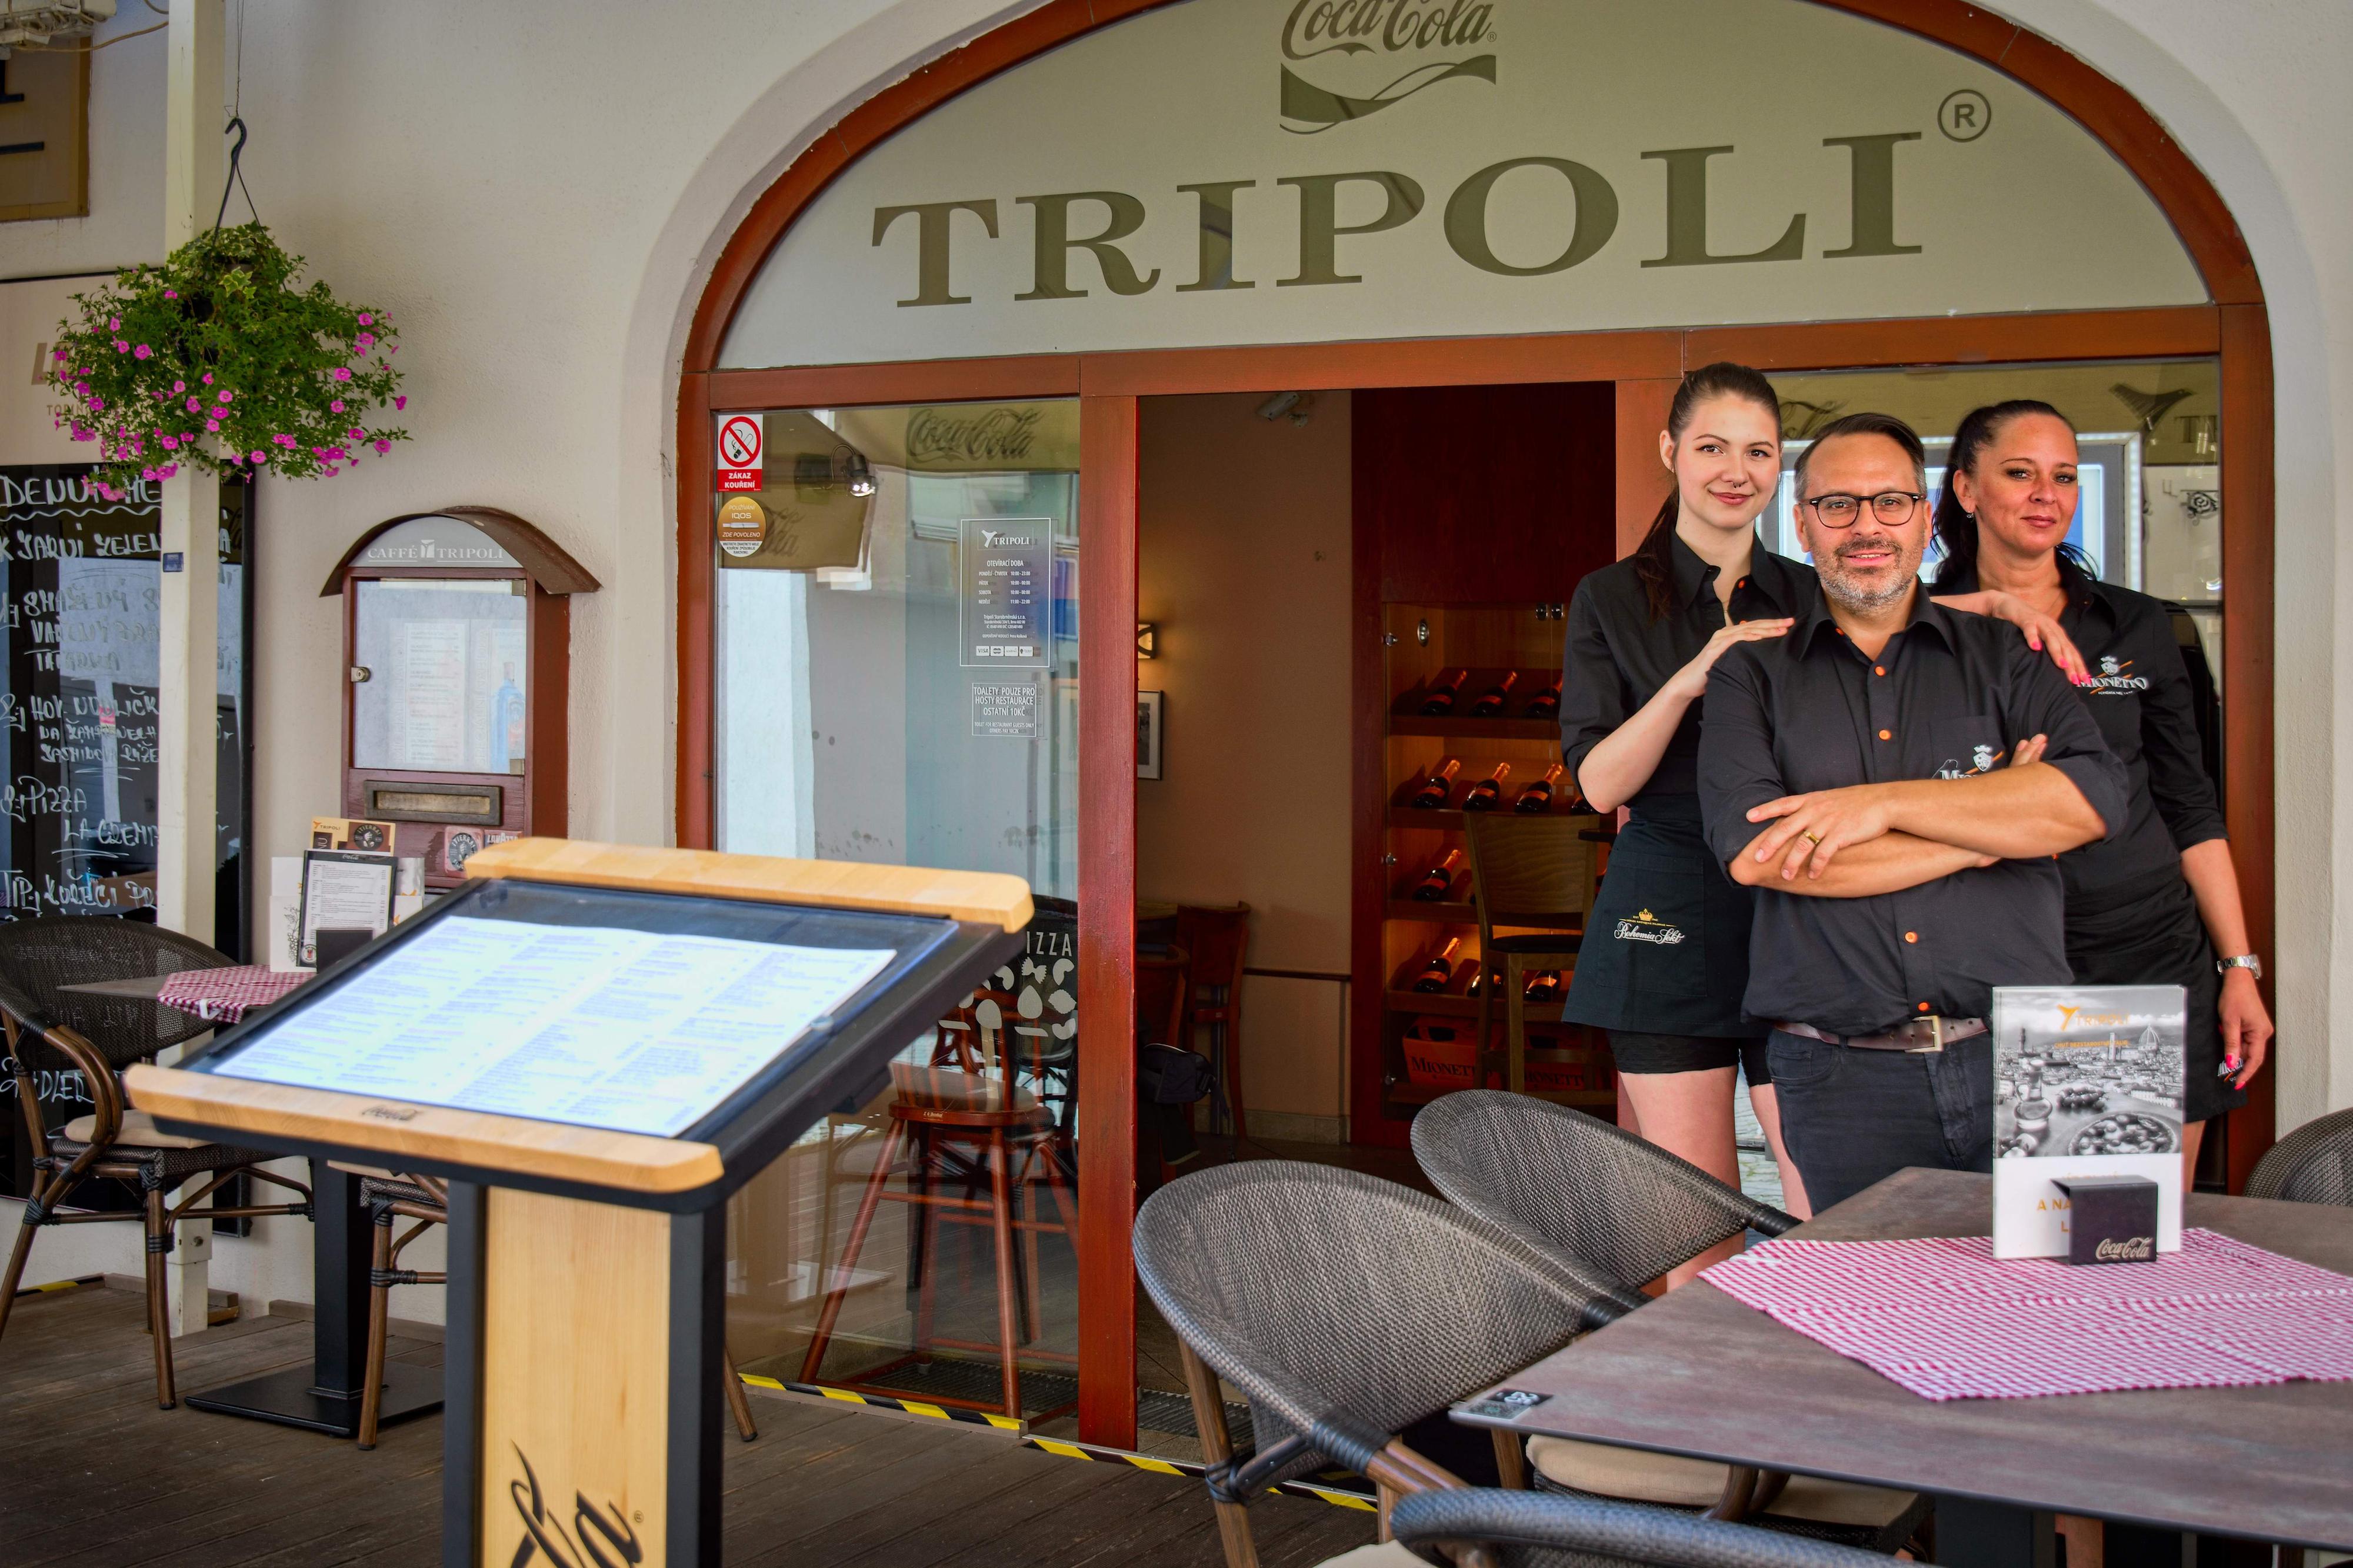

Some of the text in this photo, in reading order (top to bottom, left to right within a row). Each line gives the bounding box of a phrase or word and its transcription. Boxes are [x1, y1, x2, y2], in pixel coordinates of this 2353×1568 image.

[871, 131, 1922, 308] TRIPOLI
[994, 537, 1029, 545] TRIPOLI
[368, 545, 504, 558] CAFFÉ TRIPOLI
[987, 559, 1010, 567] OTEVÍRACÍ
[974, 687, 1035, 696] TOALETY POUZE PRO
[975, 696, 1034, 705] HOSTY RESTAURACE
[983, 706, 1025, 716] OSTATNÍ 10KČ
[1614, 921, 1685, 944] Bohemia Sekt
[1026, 931, 1072, 956] IZZA
[2077, 1013, 2129, 1026] TRIPOLI
[1524, 1069, 1584, 1086] IONETT
[2095, 1237, 2153, 1259] Coca-Cola
